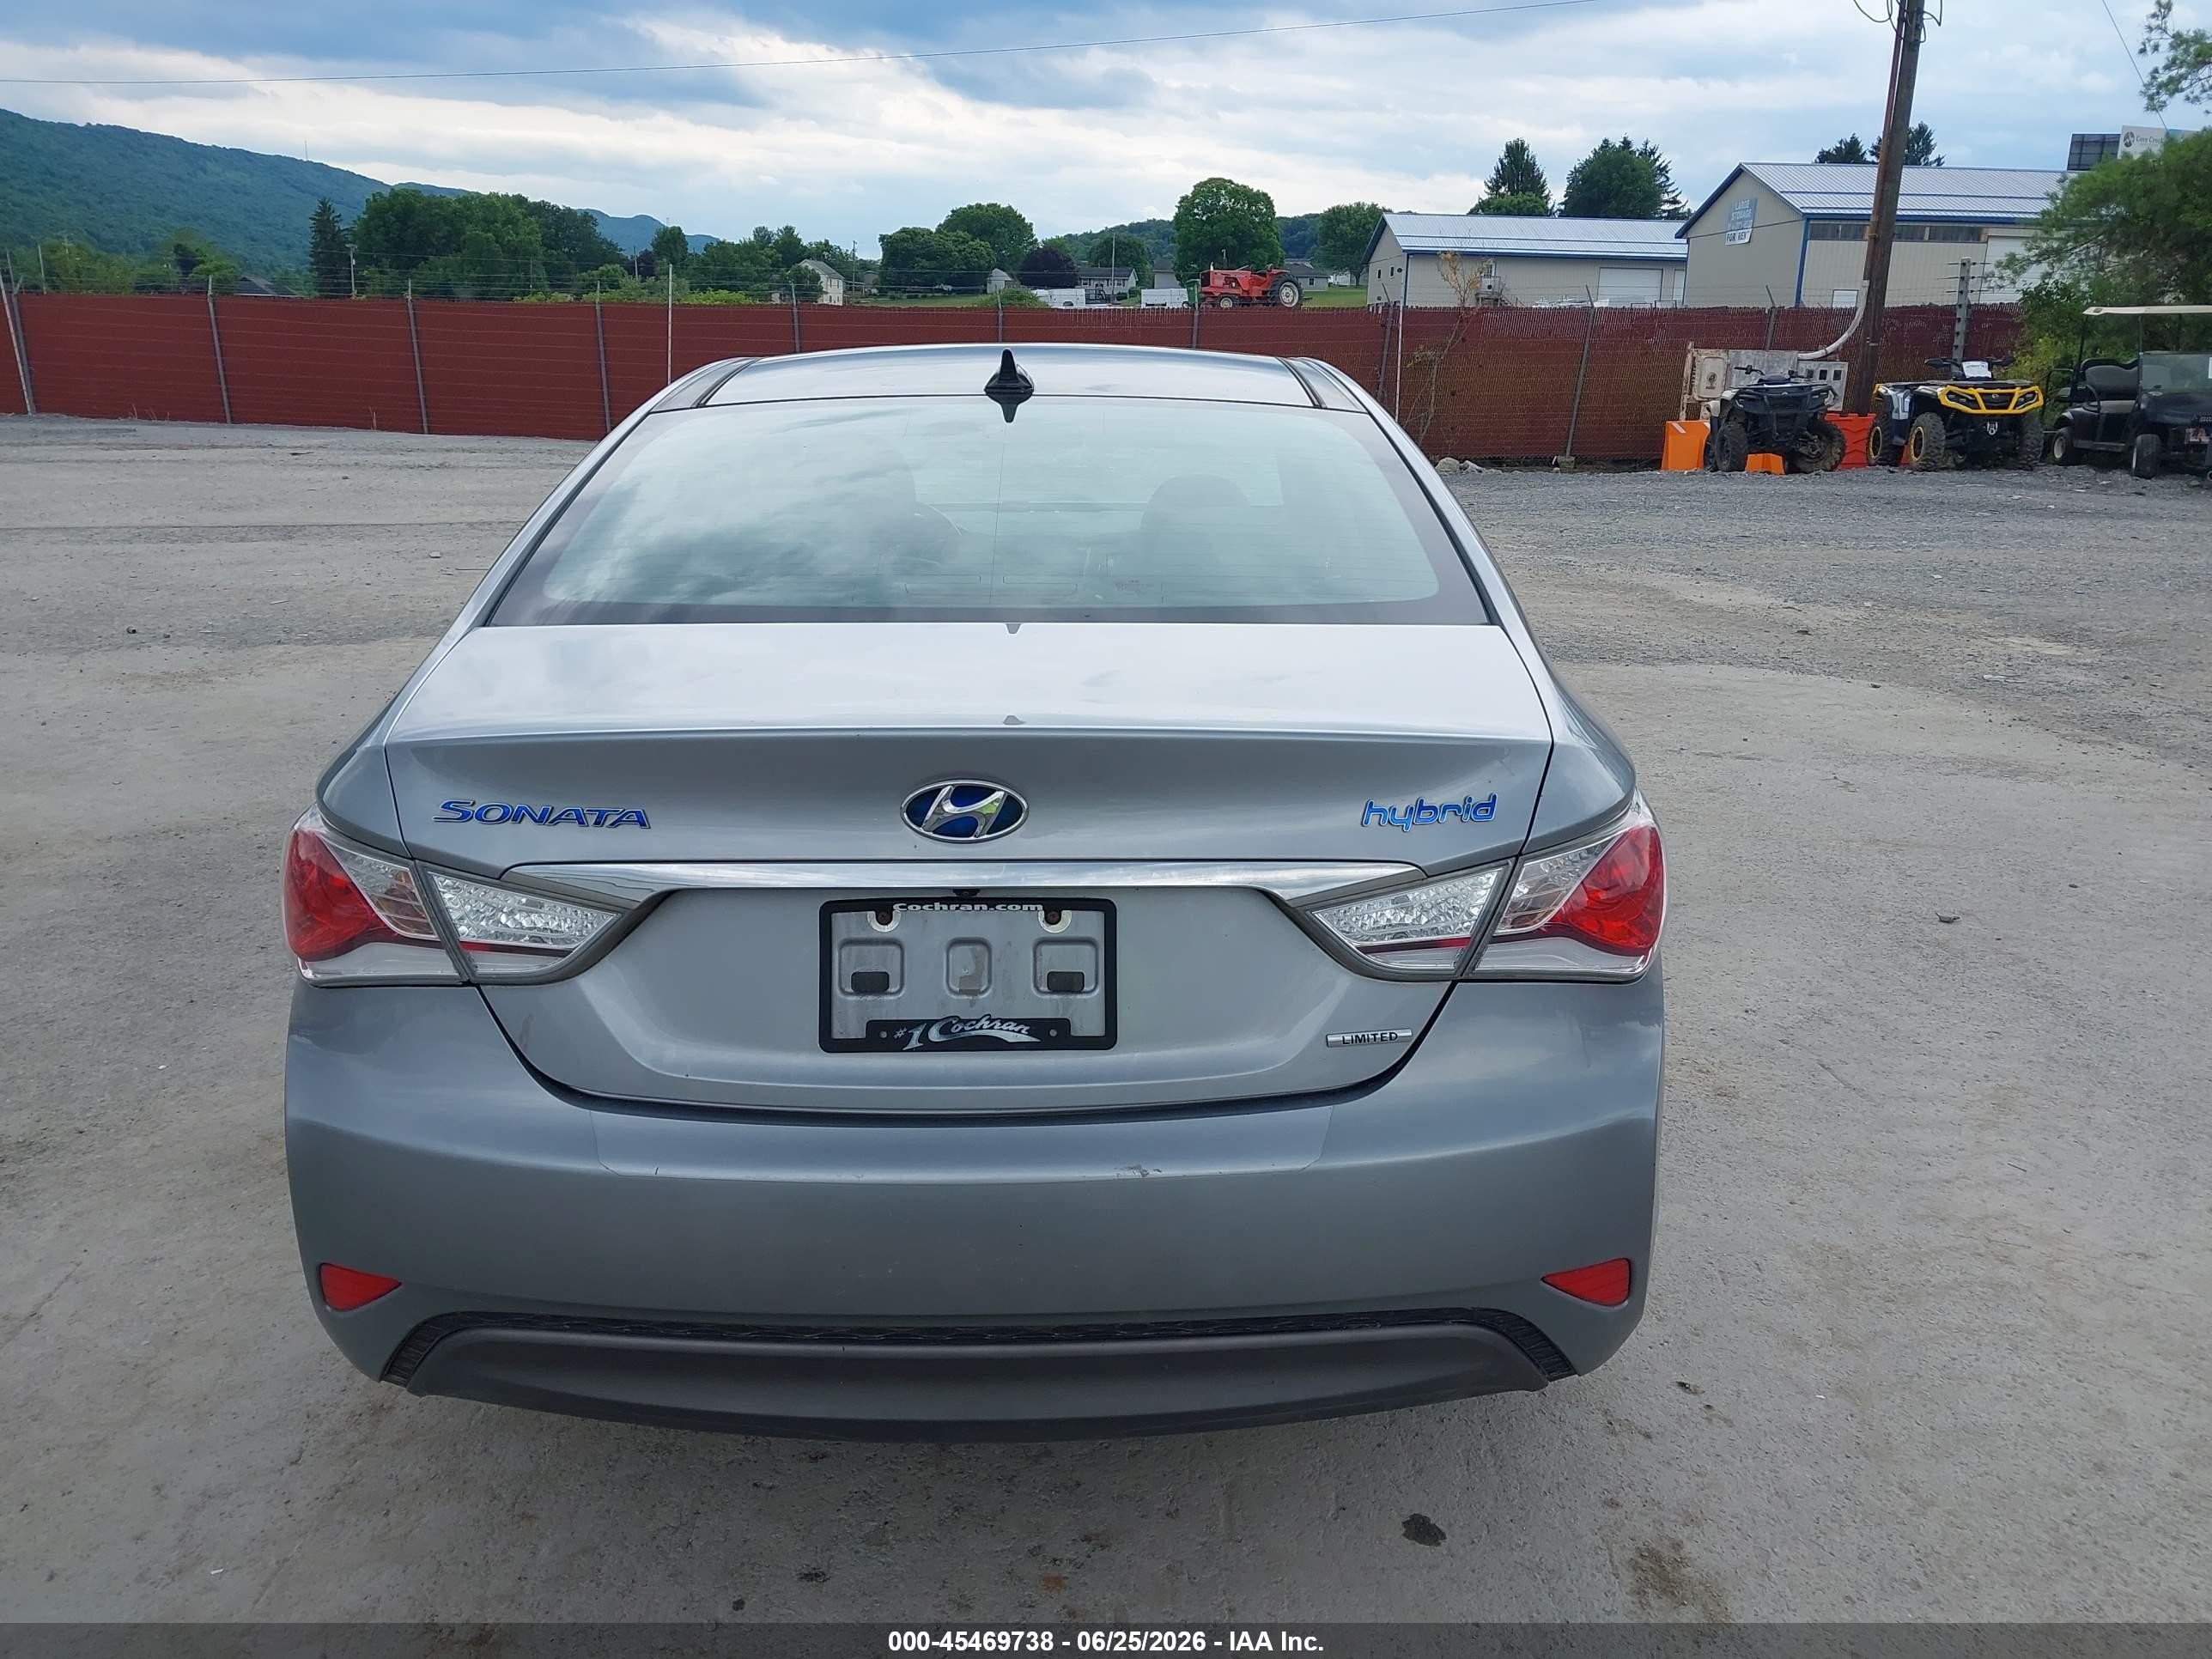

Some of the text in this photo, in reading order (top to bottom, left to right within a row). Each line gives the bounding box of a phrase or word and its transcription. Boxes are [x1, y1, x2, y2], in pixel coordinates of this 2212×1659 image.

[1727, 230, 1750, 241] FOR RENT
[432, 800, 650, 829] SONATA
[1362, 793, 1498, 831] hybrid
[893, 902, 1043, 912] Cochran.com
[928, 1014, 1033, 1042] Cochran
[1341, 1031, 1398, 1044] LIMITED
